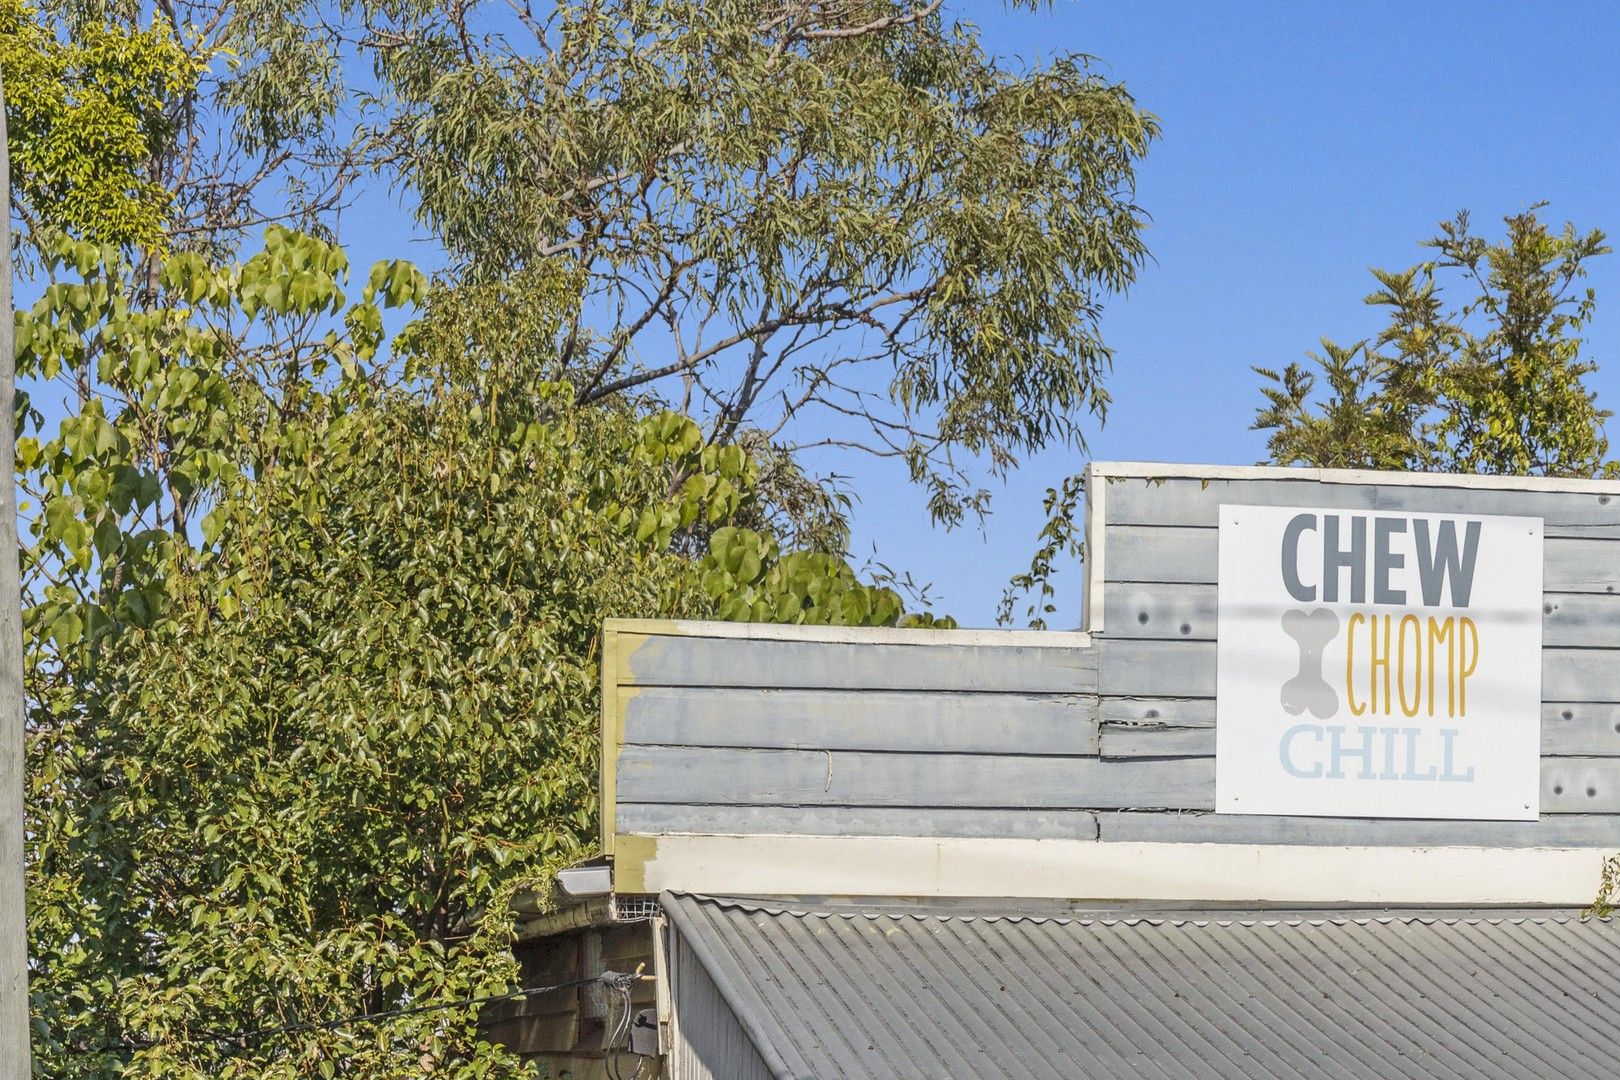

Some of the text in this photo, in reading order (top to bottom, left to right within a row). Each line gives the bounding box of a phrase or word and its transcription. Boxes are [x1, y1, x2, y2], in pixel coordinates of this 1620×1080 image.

[1281, 513, 1482, 608] CHEW
[1347, 612, 1479, 718] CHOMP
[1279, 724, 1475, 782] CHILL
